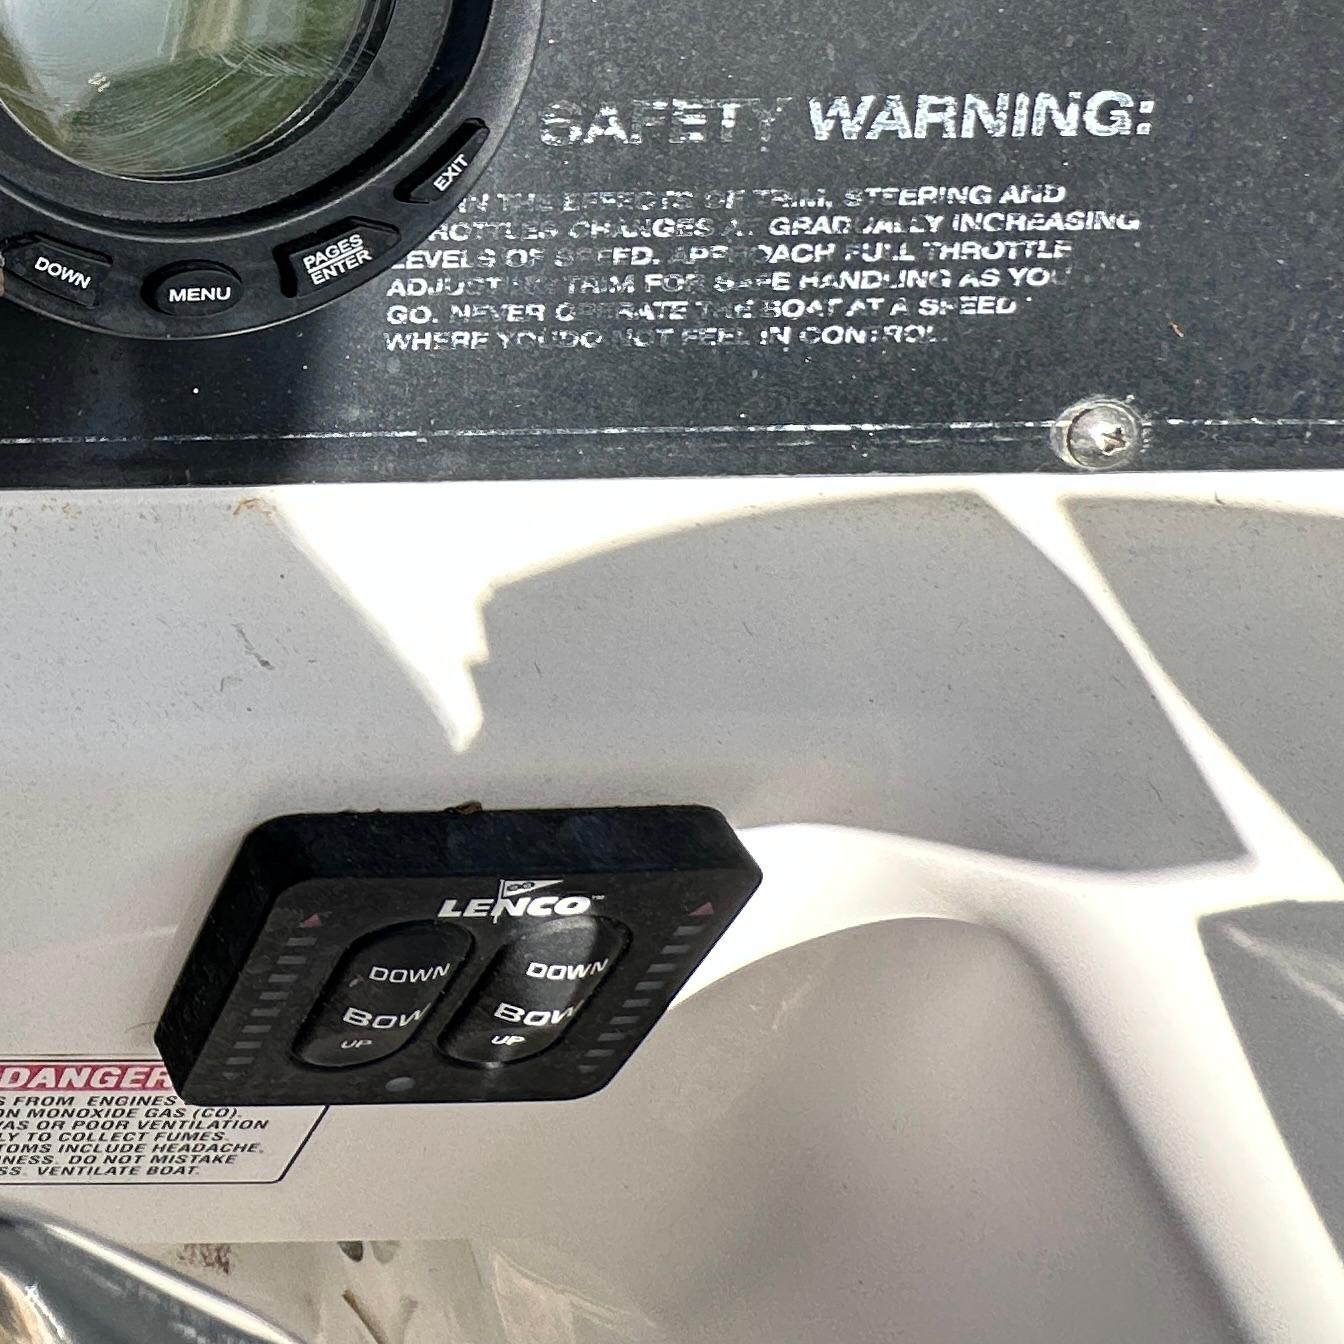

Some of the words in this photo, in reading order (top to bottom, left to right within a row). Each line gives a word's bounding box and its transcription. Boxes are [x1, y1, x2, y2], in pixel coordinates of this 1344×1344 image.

[541, 96, 793, 146] SAFETY
[809, 89, 1154, 141] WARNING:
[433, 153, 468, 192] EXIT
[844, 185, 992, 207] STEERING
[999, 183, 1067, 204] AND
[952, 210, 1141, 233] INCREASING
[303, 233, 364, 270] PAGES
[505, 246, 544, 268] OF
[923, 239, 1073, 262] THROTTLE
[34, 256, 91, 289] DOWN
[311, 249, 373, 286] ENTER
[644, 272, 706, 295] FOR
[799, 268, 952, 291] HANDLING
[958, 267, 1000, 288] AS
[169, 287, 231, 302] MENU
[386, 303, 438, 325] GO.
[449, 301, 545, 324] NEVER
[890, 296, 910, 317] A
[384, 331, 489, 352] WHERE
[369, 962, 451, 984] DOWN
[526, 958, 609, 980] DOWN
[342, 1002, 432, 1030] BOW
[493, 999, 586, 1027] BOW
[340, 1039, 373, 1049] UP
[491, 1034, 527, 1047] UP
[13, 1096, 75, 1106] FROM
[87, 1096, 178, 1106] ENGINES
[27, 1108, 138, 1118] MONOXIDE
[145, 1108, 186, 1118] GAS
[36, 1120, 64, 1130] OR
[71, 1120, 130, 1130] POOR
[137, 1119, 269, 1130] VENTILATION
[27, 1132, 58, 1142] TO
[59, 1131, 147, 1142] COLLECT
[58, 1143, 147, 1154] INCLUDE
[68, 1155, 97, 1165] DO
[103, 1155, 143, 1165] NOT
[150, 1155, 238, 1165] MISTAKE
[37, 1166, 142, 1177] VENTILATE
